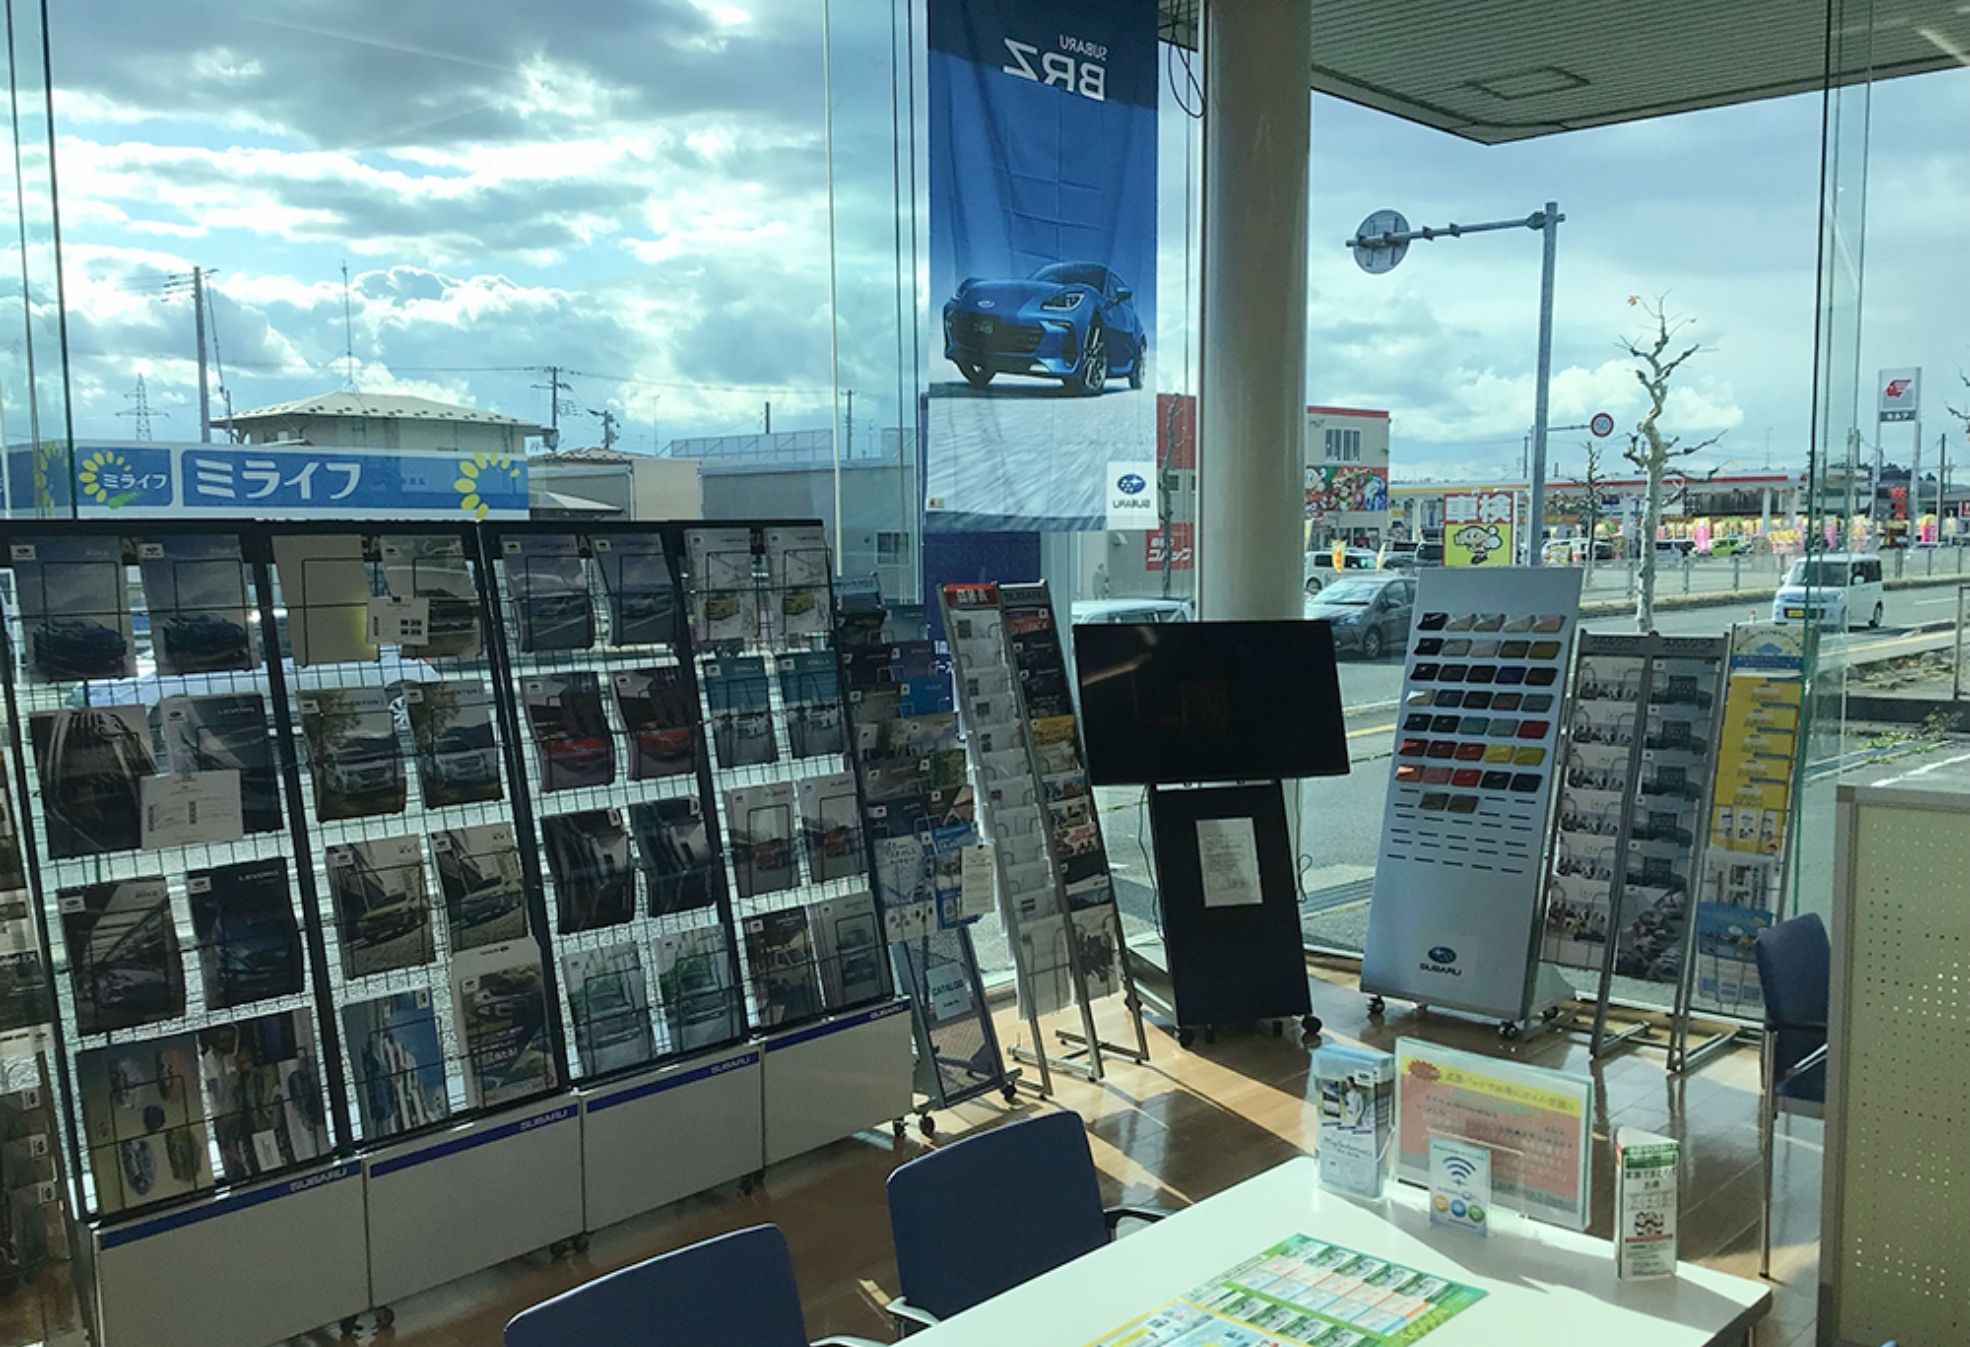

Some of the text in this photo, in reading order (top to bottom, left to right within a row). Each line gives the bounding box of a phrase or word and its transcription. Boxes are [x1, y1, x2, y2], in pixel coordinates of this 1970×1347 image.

[102, 473, 167, 490] ミライフ
[196, 458, 362, 500] ミライフ
[1445, 494, 1512, 523] 車検
[1419, 962, 1463, 977] SUBARU
[520, 1108, 569, 1130] SUBARU
[289, 1167, 348, 1193] SUBARU
